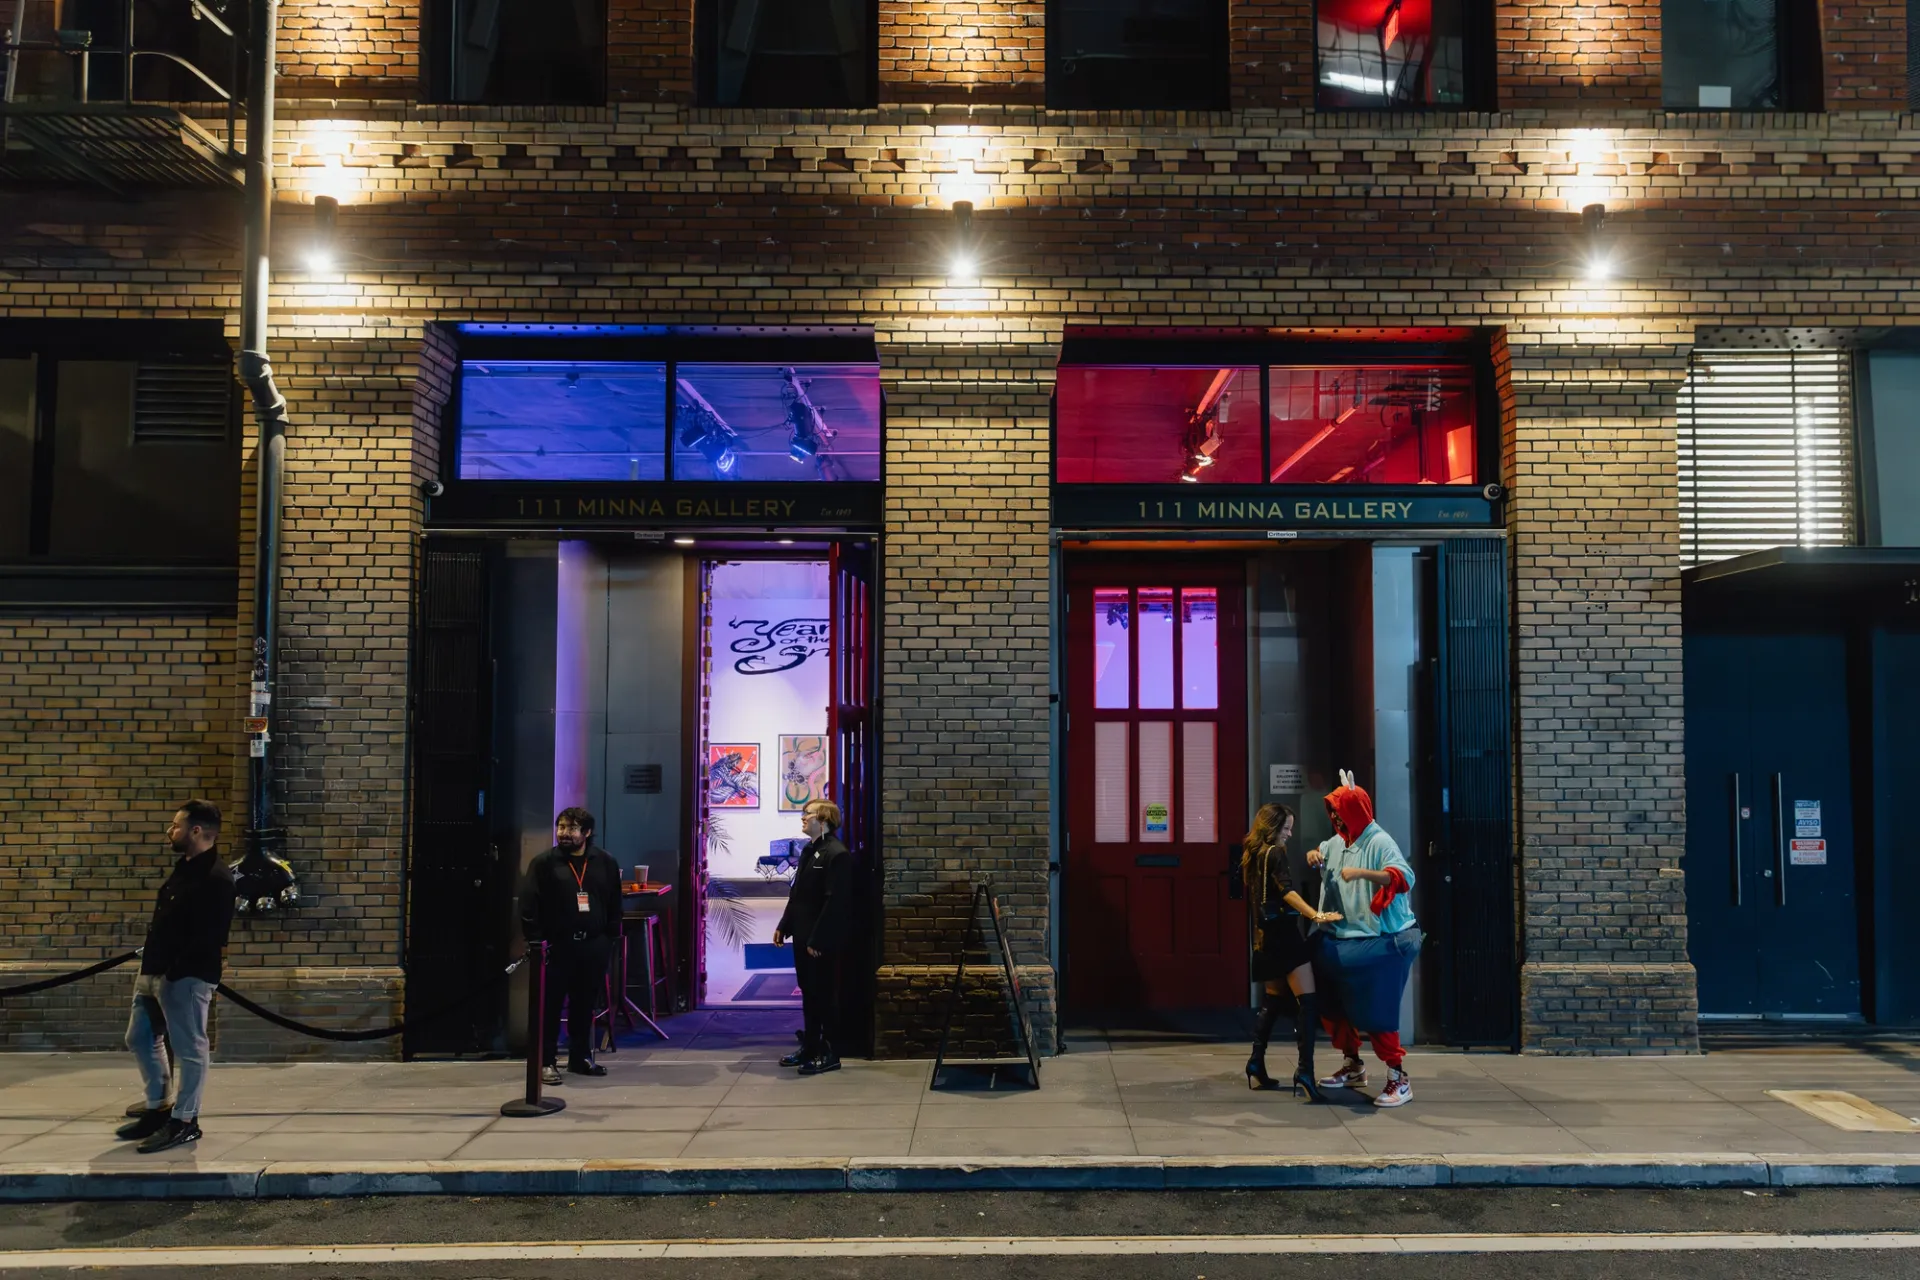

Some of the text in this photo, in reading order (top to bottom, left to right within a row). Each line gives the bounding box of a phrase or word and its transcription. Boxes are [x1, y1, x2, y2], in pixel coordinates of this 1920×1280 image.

[518, 498, 796, 517] 111 MINNA GALLERY
[1139, 501, 1413, 519] 111 MINNA GALLERY
